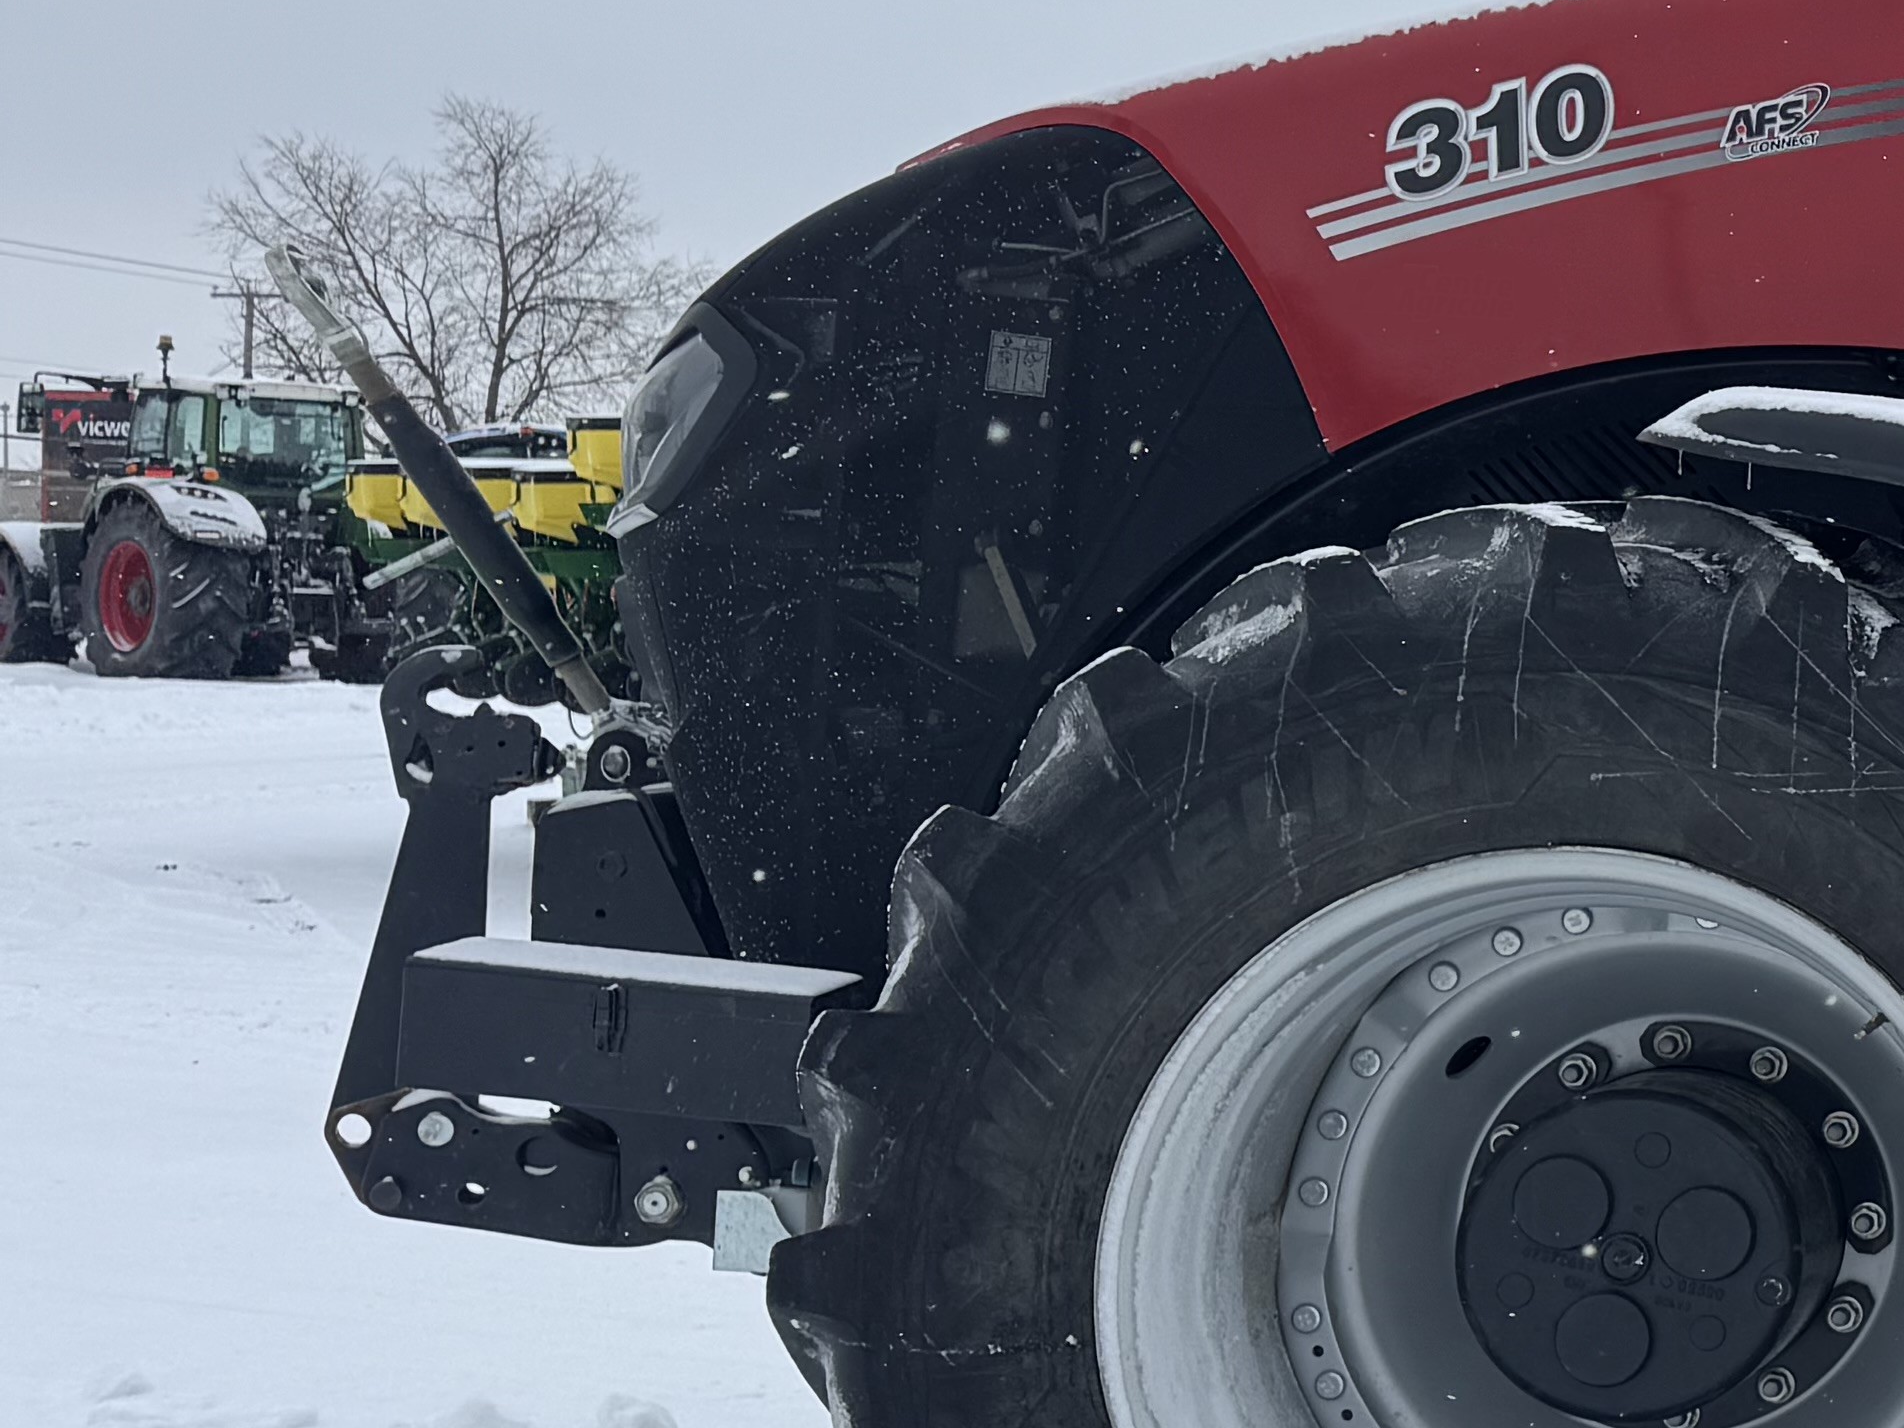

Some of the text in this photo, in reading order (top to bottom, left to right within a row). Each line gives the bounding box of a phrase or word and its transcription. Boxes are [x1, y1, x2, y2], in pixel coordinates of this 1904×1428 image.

[1385, 63, 1614, 202] 310
[1720, 95, 1807, 147] AFS
[1749, 131, 1819, 155] CONNECT
